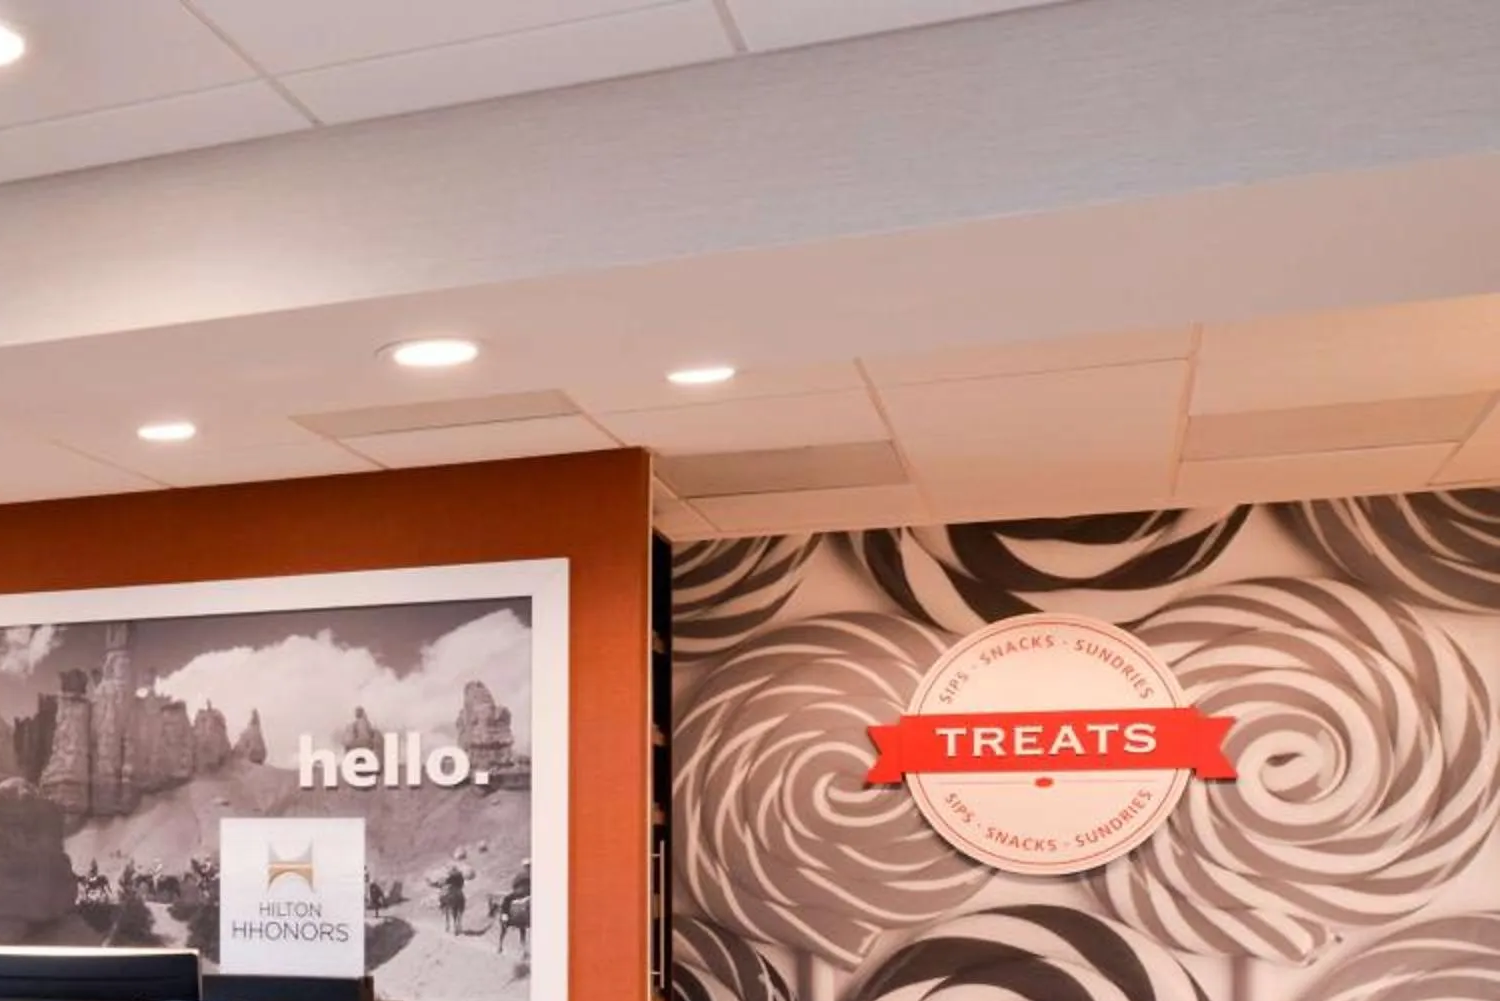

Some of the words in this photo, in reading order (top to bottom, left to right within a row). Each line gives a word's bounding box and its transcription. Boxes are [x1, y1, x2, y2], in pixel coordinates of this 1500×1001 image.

[939, 670, 969, 705] SIPS
[979, 634, 1055, 665] SNACKS
[1074, 638, 1155, 700] SUNDRIES
[299, 732, 490, 788] hello.
[934, 722, 1158, 758] TREATS
[944, 792, 975, 824] SIPS
[985, 826, 1058, 851] SNACKS
[1075, 787, 1154, 848] SUNDRIES
[232, 920, 350, 943] HHONORS
[258, 901, 323, 918] HILTON
